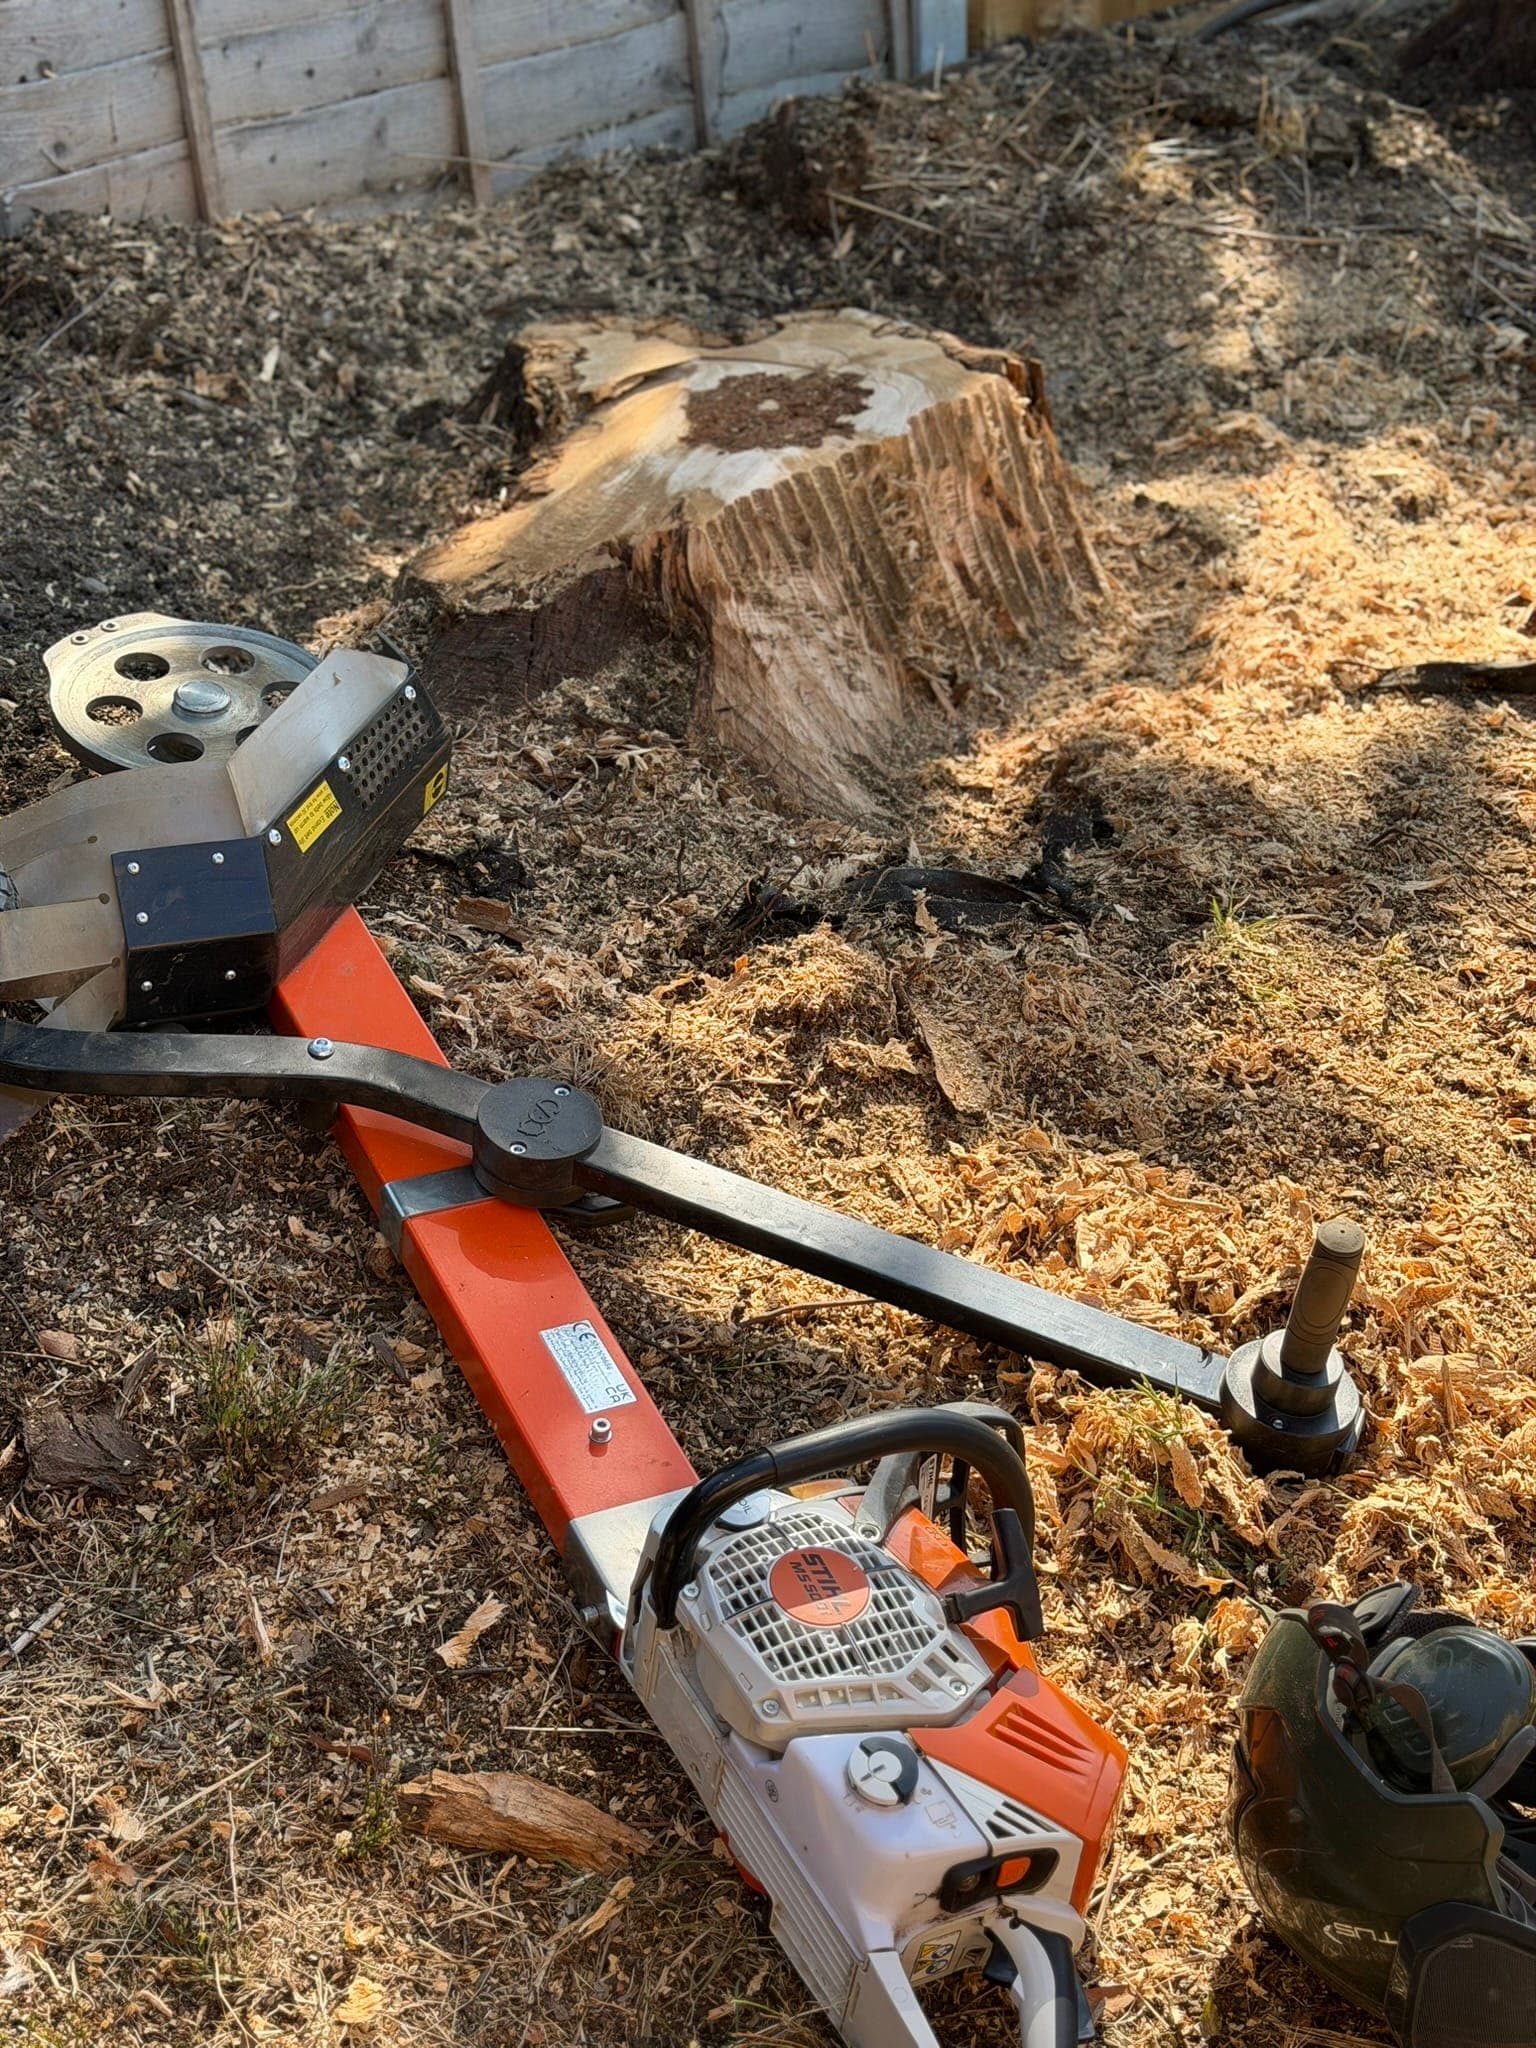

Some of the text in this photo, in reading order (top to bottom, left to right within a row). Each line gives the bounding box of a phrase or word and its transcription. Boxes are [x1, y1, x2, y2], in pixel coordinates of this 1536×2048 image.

[616, 1383, 632, 1400] UK
[739, 1498, 752, 1515] OIL
[789, 1561, 812, 1583] MS
[801, 1553, 852, 1615] STIHL
